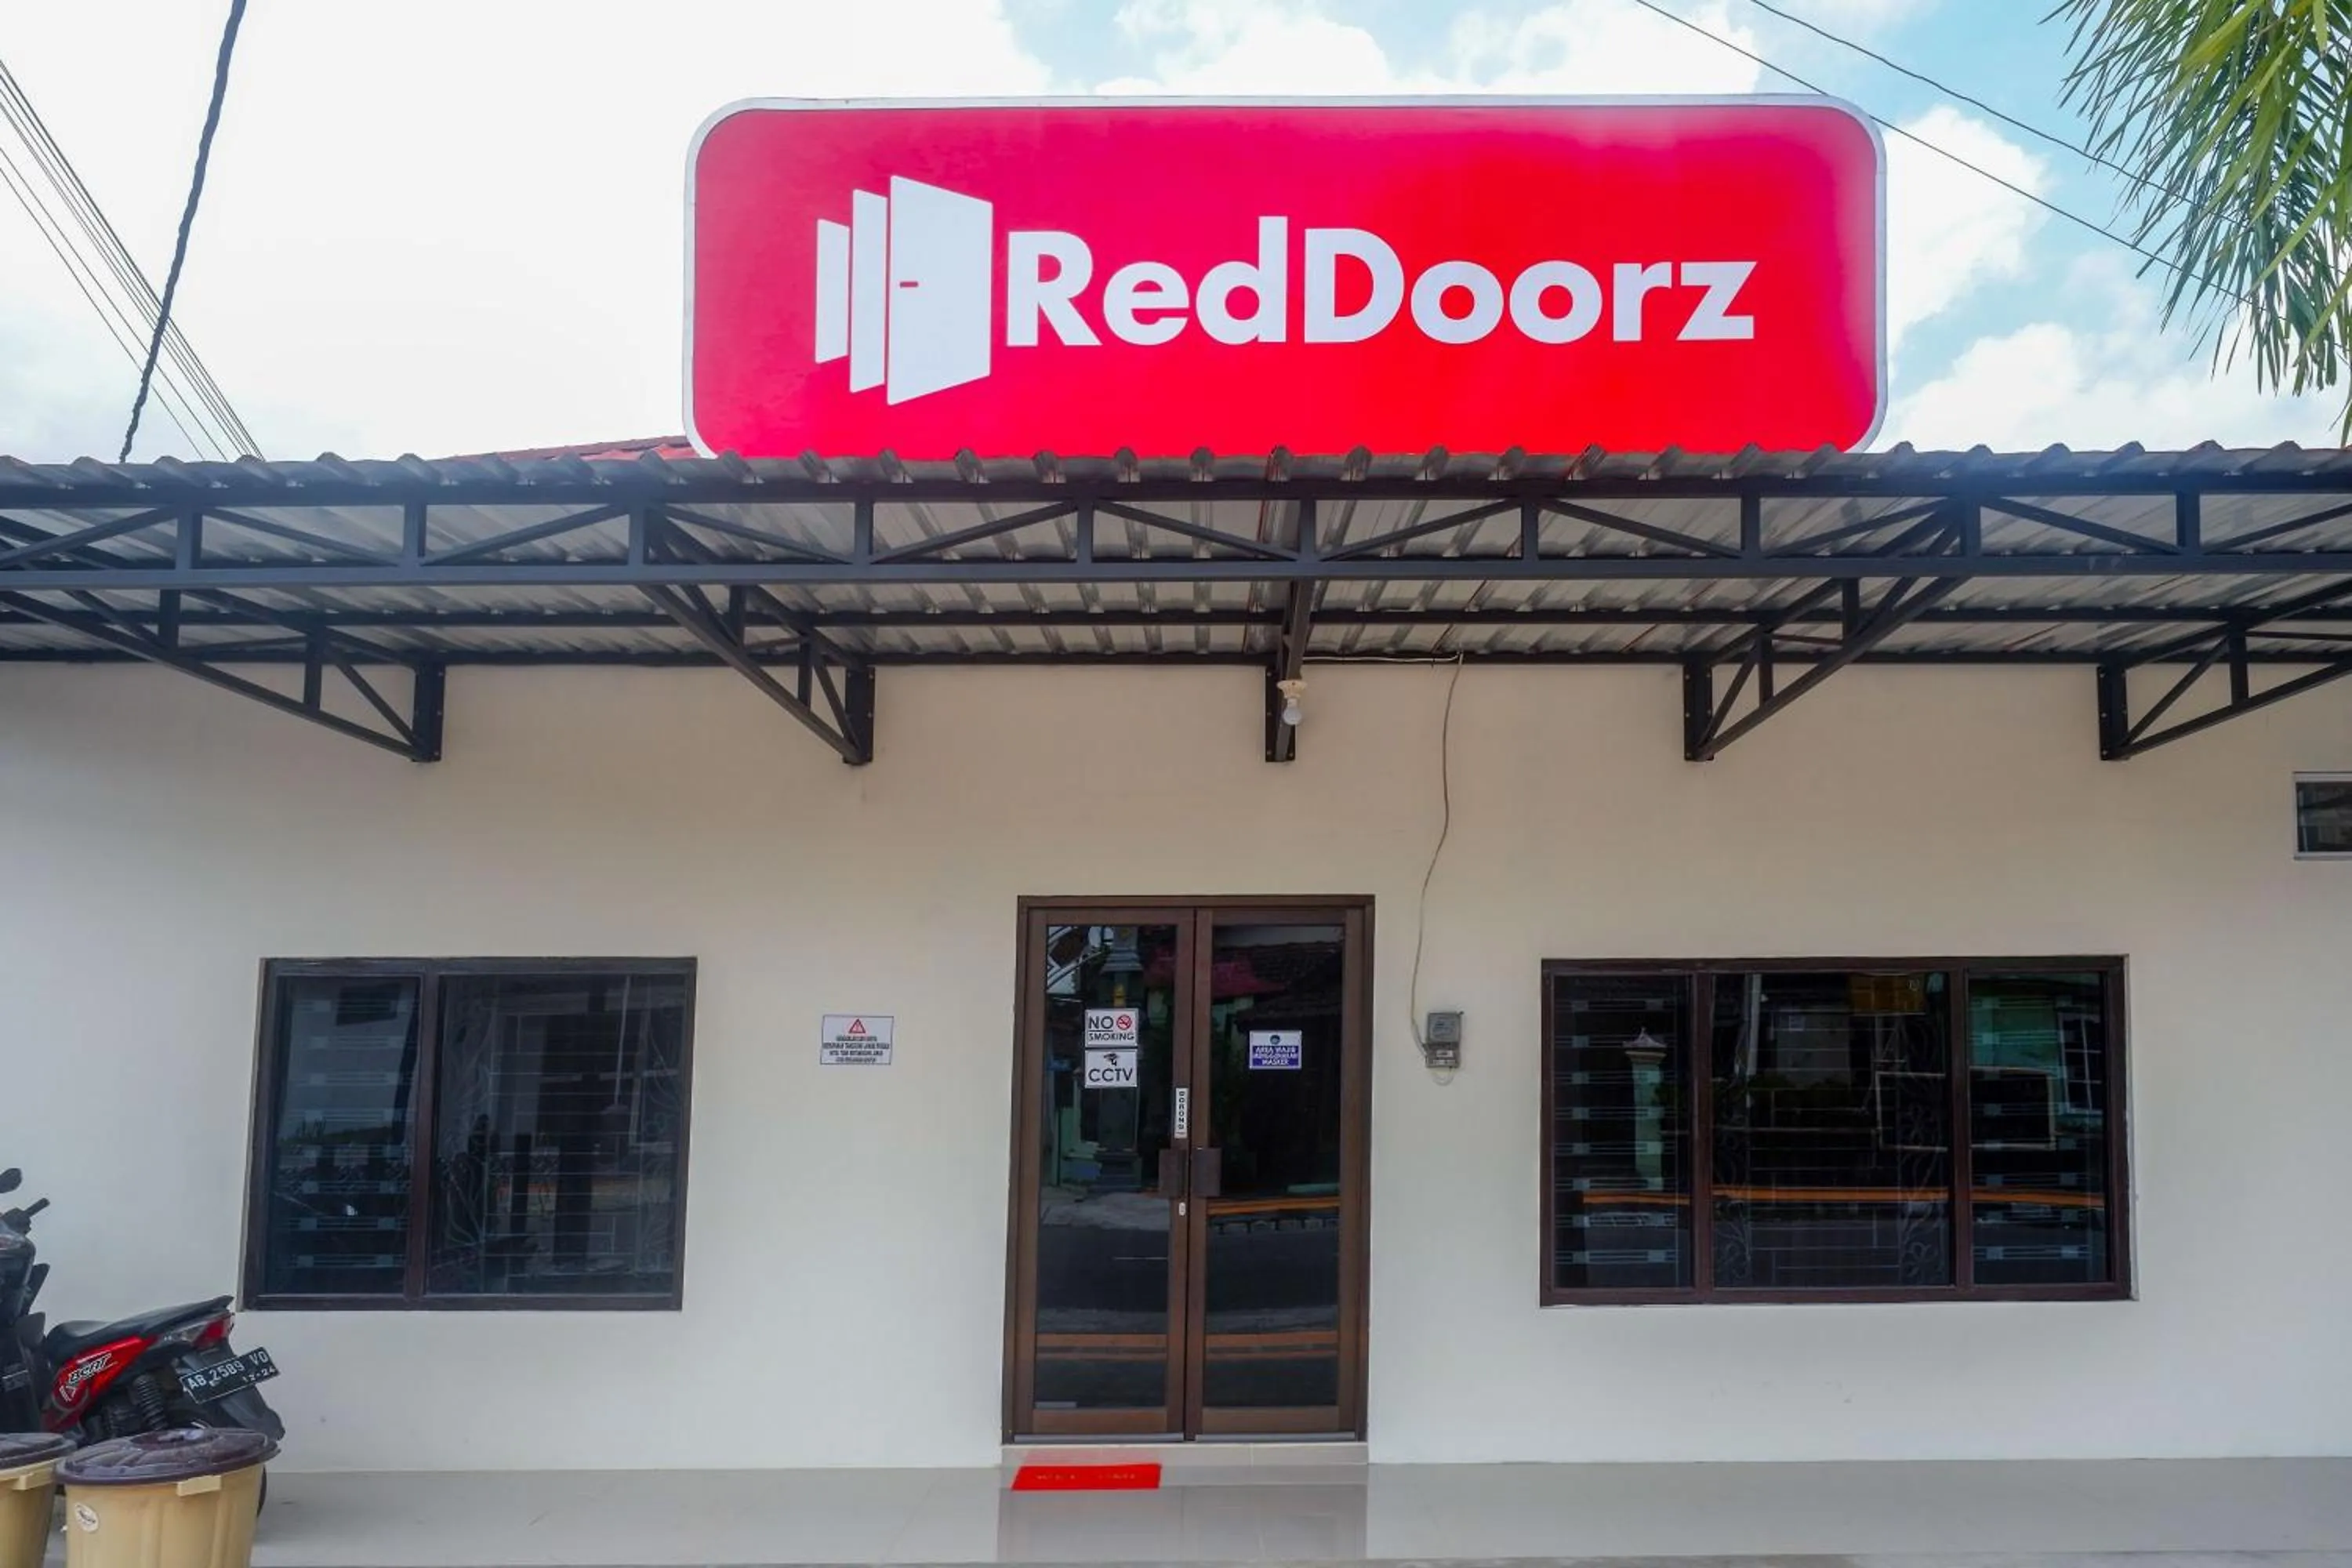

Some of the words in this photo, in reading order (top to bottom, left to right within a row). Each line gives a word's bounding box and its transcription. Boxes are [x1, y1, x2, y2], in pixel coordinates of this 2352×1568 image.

[1007, 216, 1756, 347] RedDoorz
[1088, 1016, 1113, 1029] NO
[1088, 1033, 1134, 1041] SMOKING
[1088, 1068, 1133, 1082] CCTV
